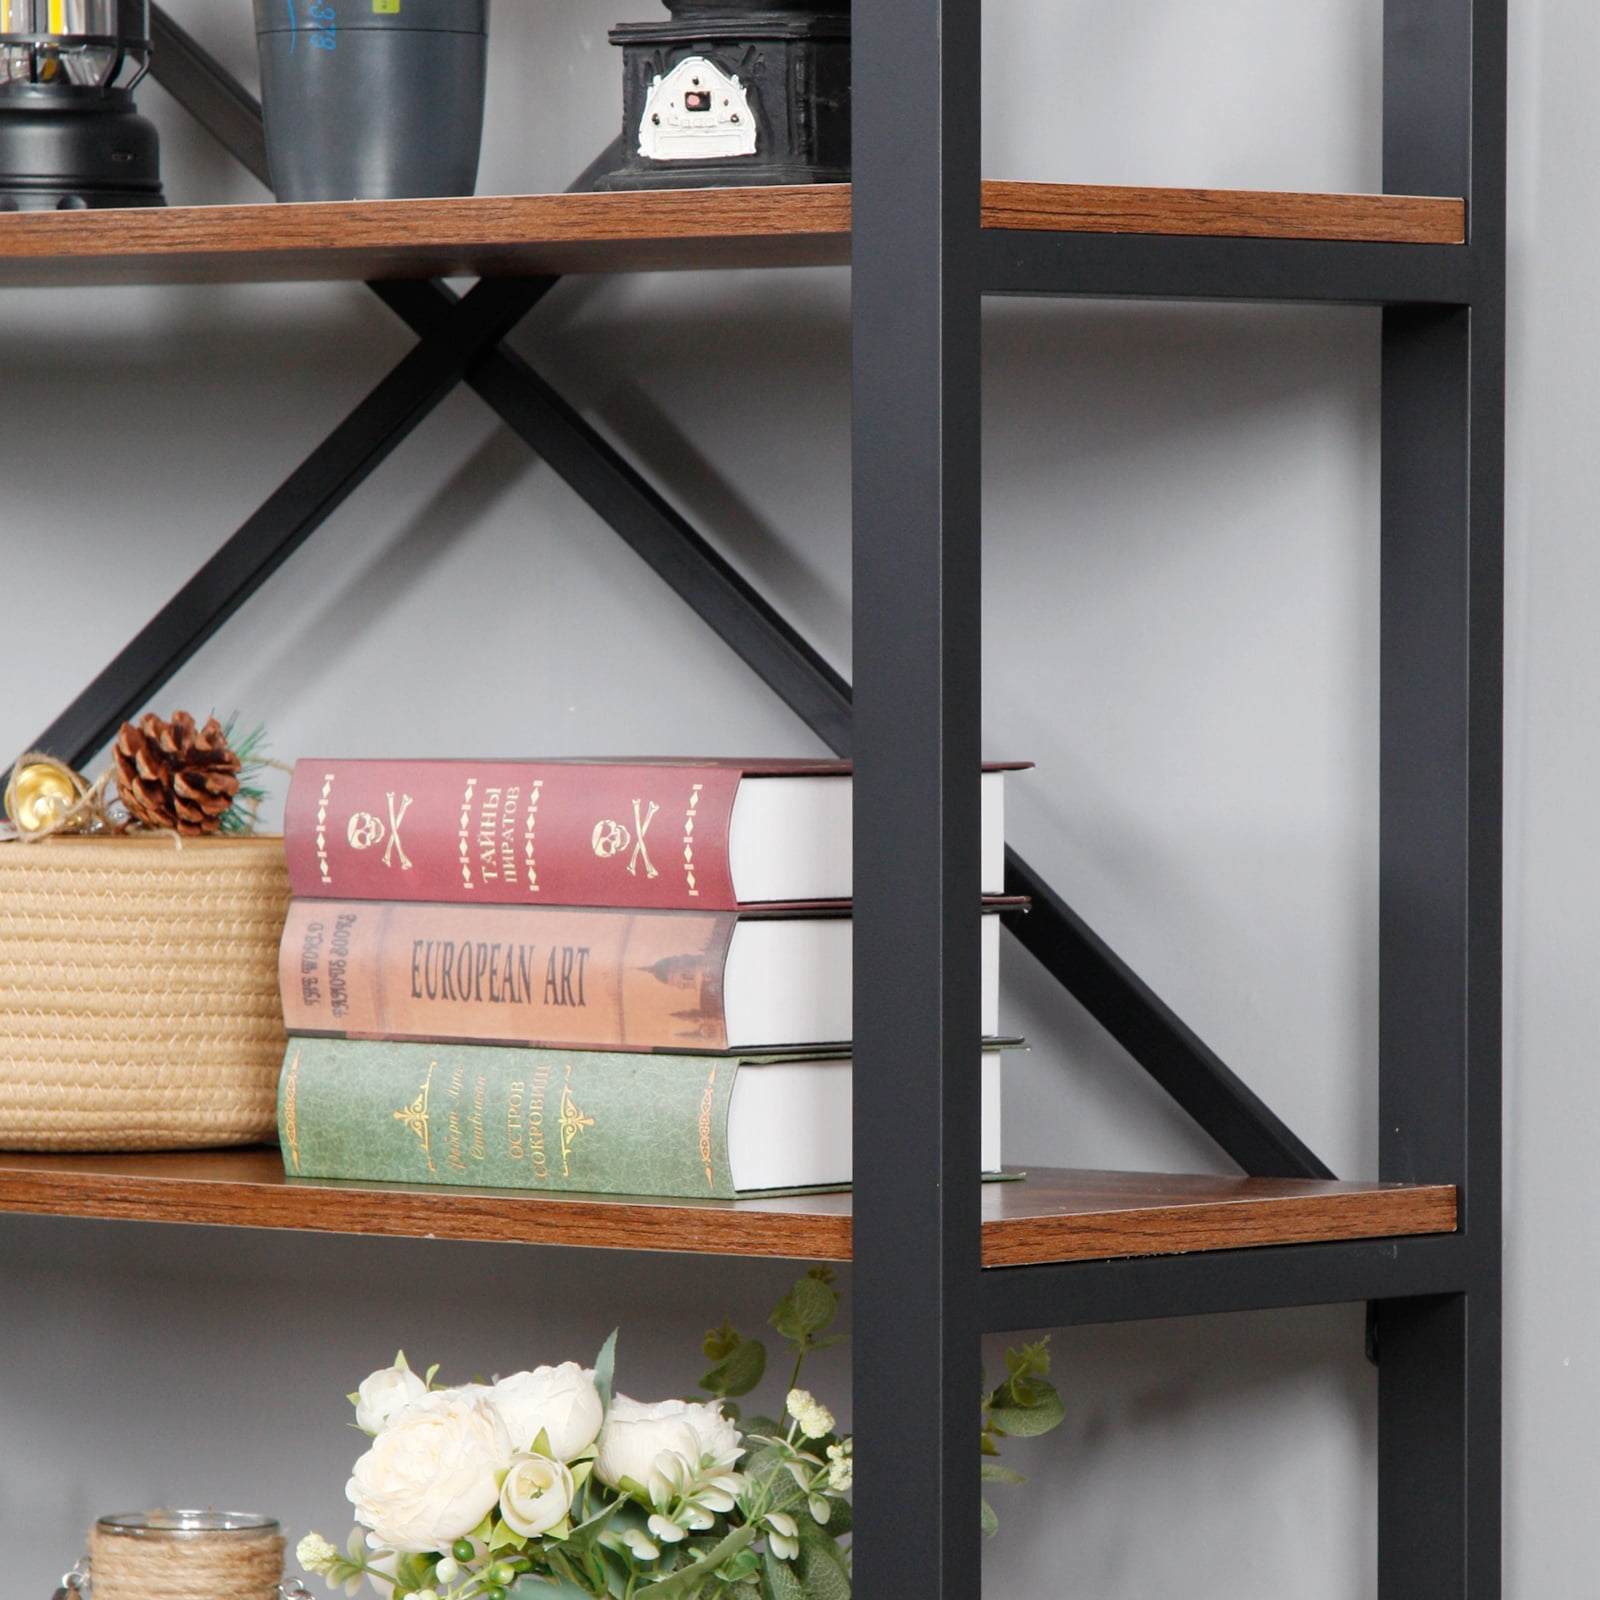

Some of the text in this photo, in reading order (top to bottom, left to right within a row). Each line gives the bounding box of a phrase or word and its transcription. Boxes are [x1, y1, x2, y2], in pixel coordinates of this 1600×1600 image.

[477, 788, 501, 884] ТАЙНЫ
[501, 786, 520, 883] ПИРАТОВ
[301, 922, 324, 1006] THE WORLD
[328, 914, 357, 1018] FAMOUS BOOKS
[411, 939, 591, 1008] EUROPEAN ART
[508, 1080, 525, 1159] ОСТРОВ
[528, 1064, 552, 1177] СОКРОВИЩ
